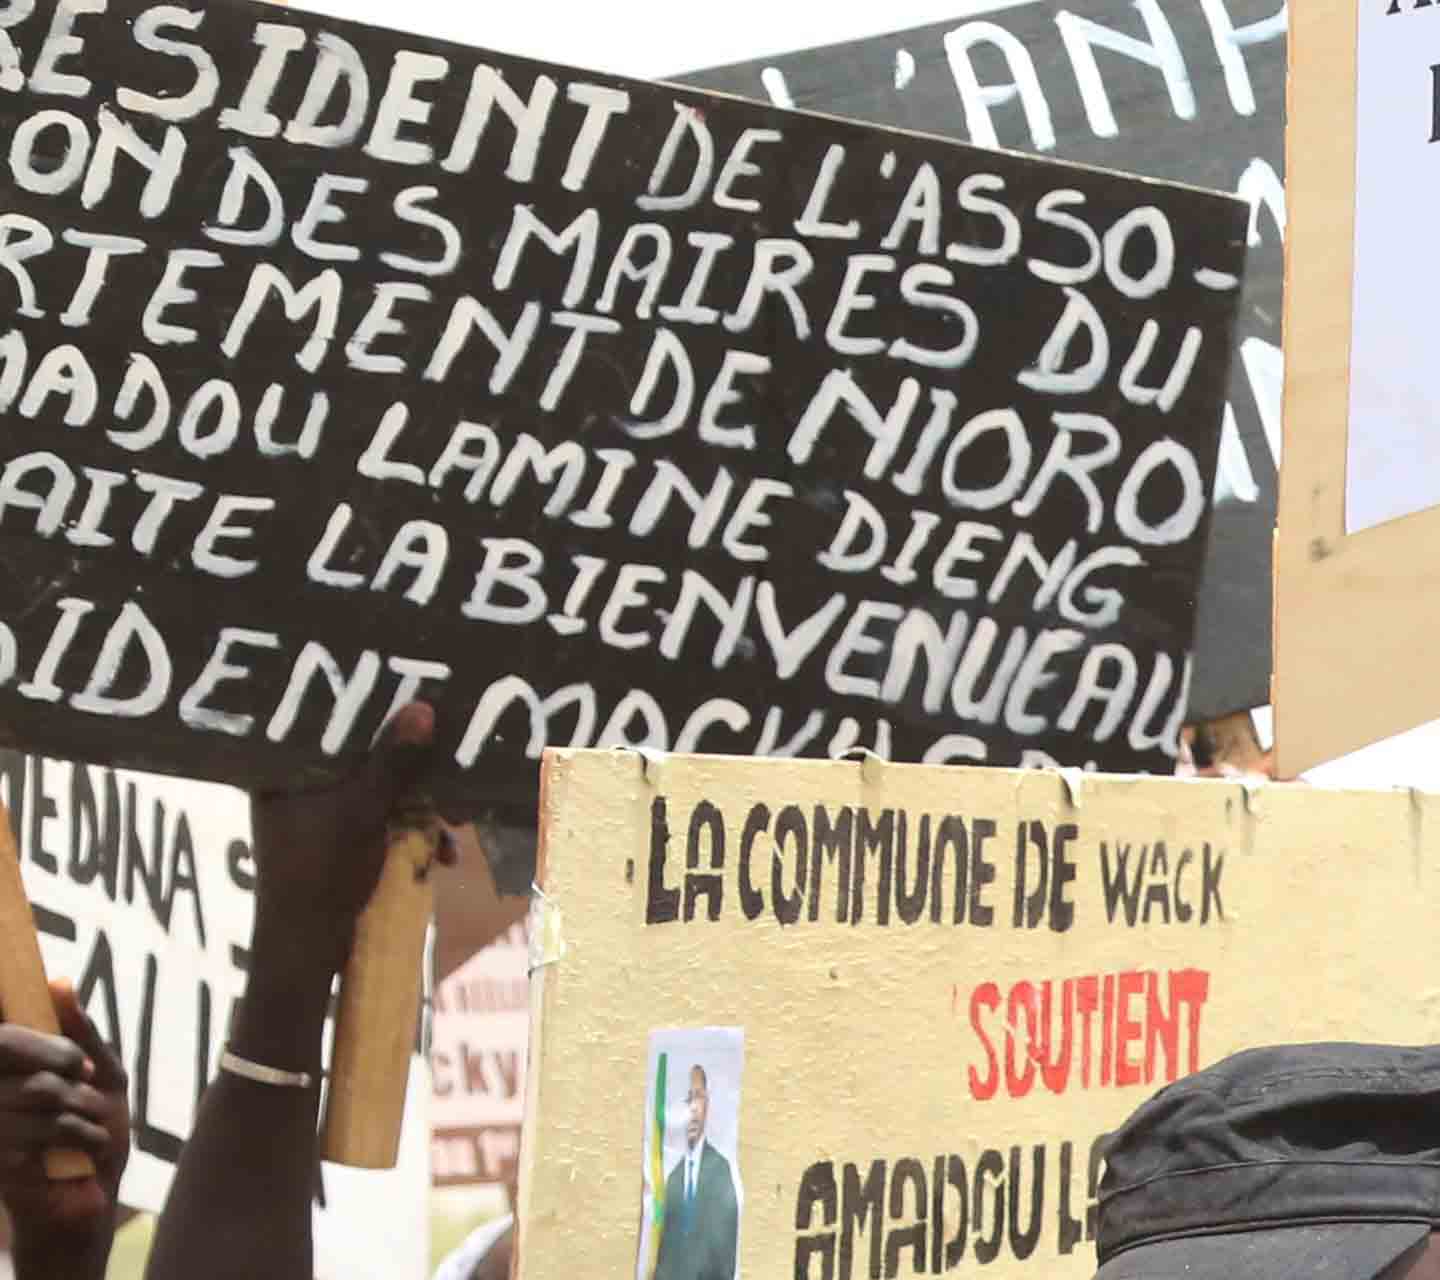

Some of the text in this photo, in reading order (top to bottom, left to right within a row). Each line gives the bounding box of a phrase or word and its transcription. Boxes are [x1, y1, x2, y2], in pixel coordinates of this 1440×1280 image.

[640, 101, 782, 213] DE
[8, 108, 1202, 410] ON DES MAIRES DU
[628, 328, 772, 450] DE
[788, 370, 1205, 545] NIORO
[307, 504, 448, 607] LA
[360, 403, 793, 562] LAMINE
[817, 491, 1146, 627] DIENG
[738, 799, 997, 928] COMMUNE
[1013, 818, 1077, 933] DE
[1099, 840, 1227, 926] WACK
[967, 968, 1211, 1102] SOUTIENT
